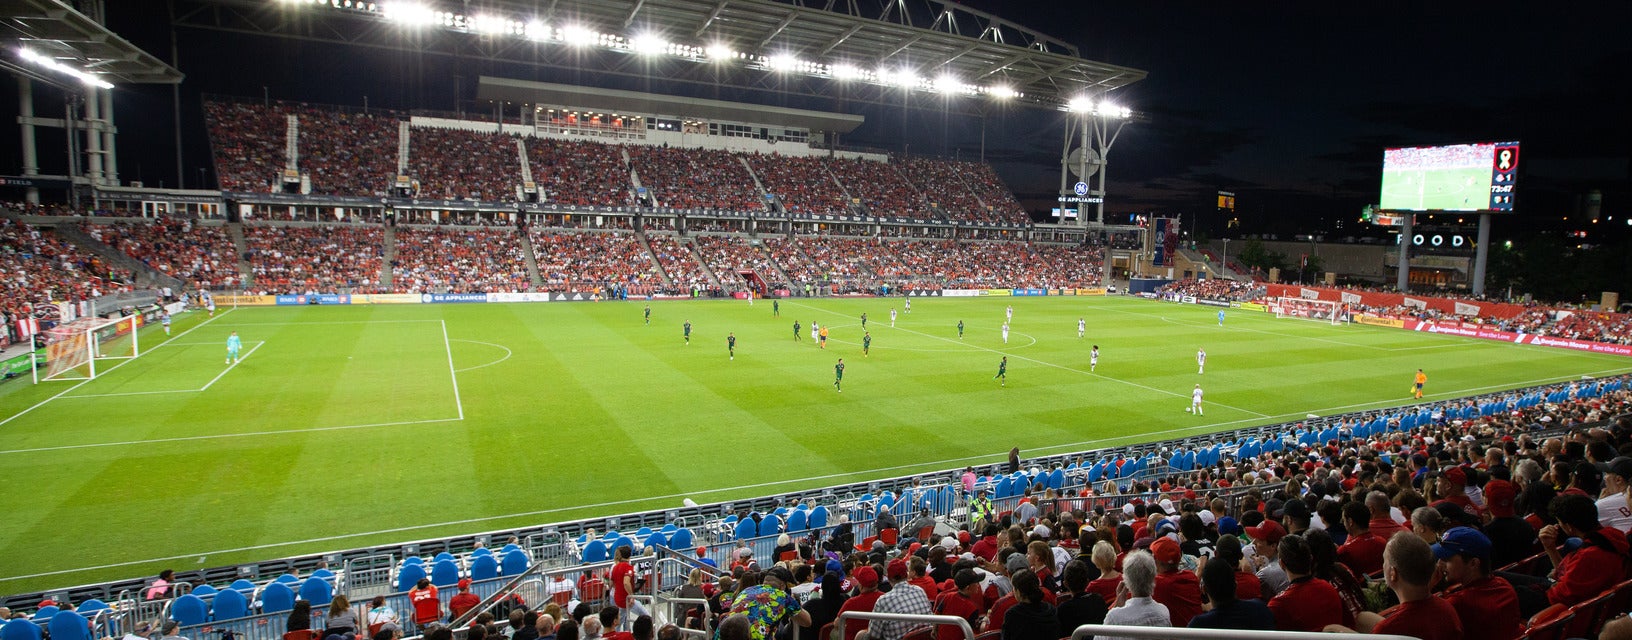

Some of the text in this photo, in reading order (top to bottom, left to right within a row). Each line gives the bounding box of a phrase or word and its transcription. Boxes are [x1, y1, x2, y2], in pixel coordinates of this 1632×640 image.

[1506, 174, 1512, 182] 1
[1361, 317, 1391, 325] Continental
[1569, 341, 1590, 349] Moore
